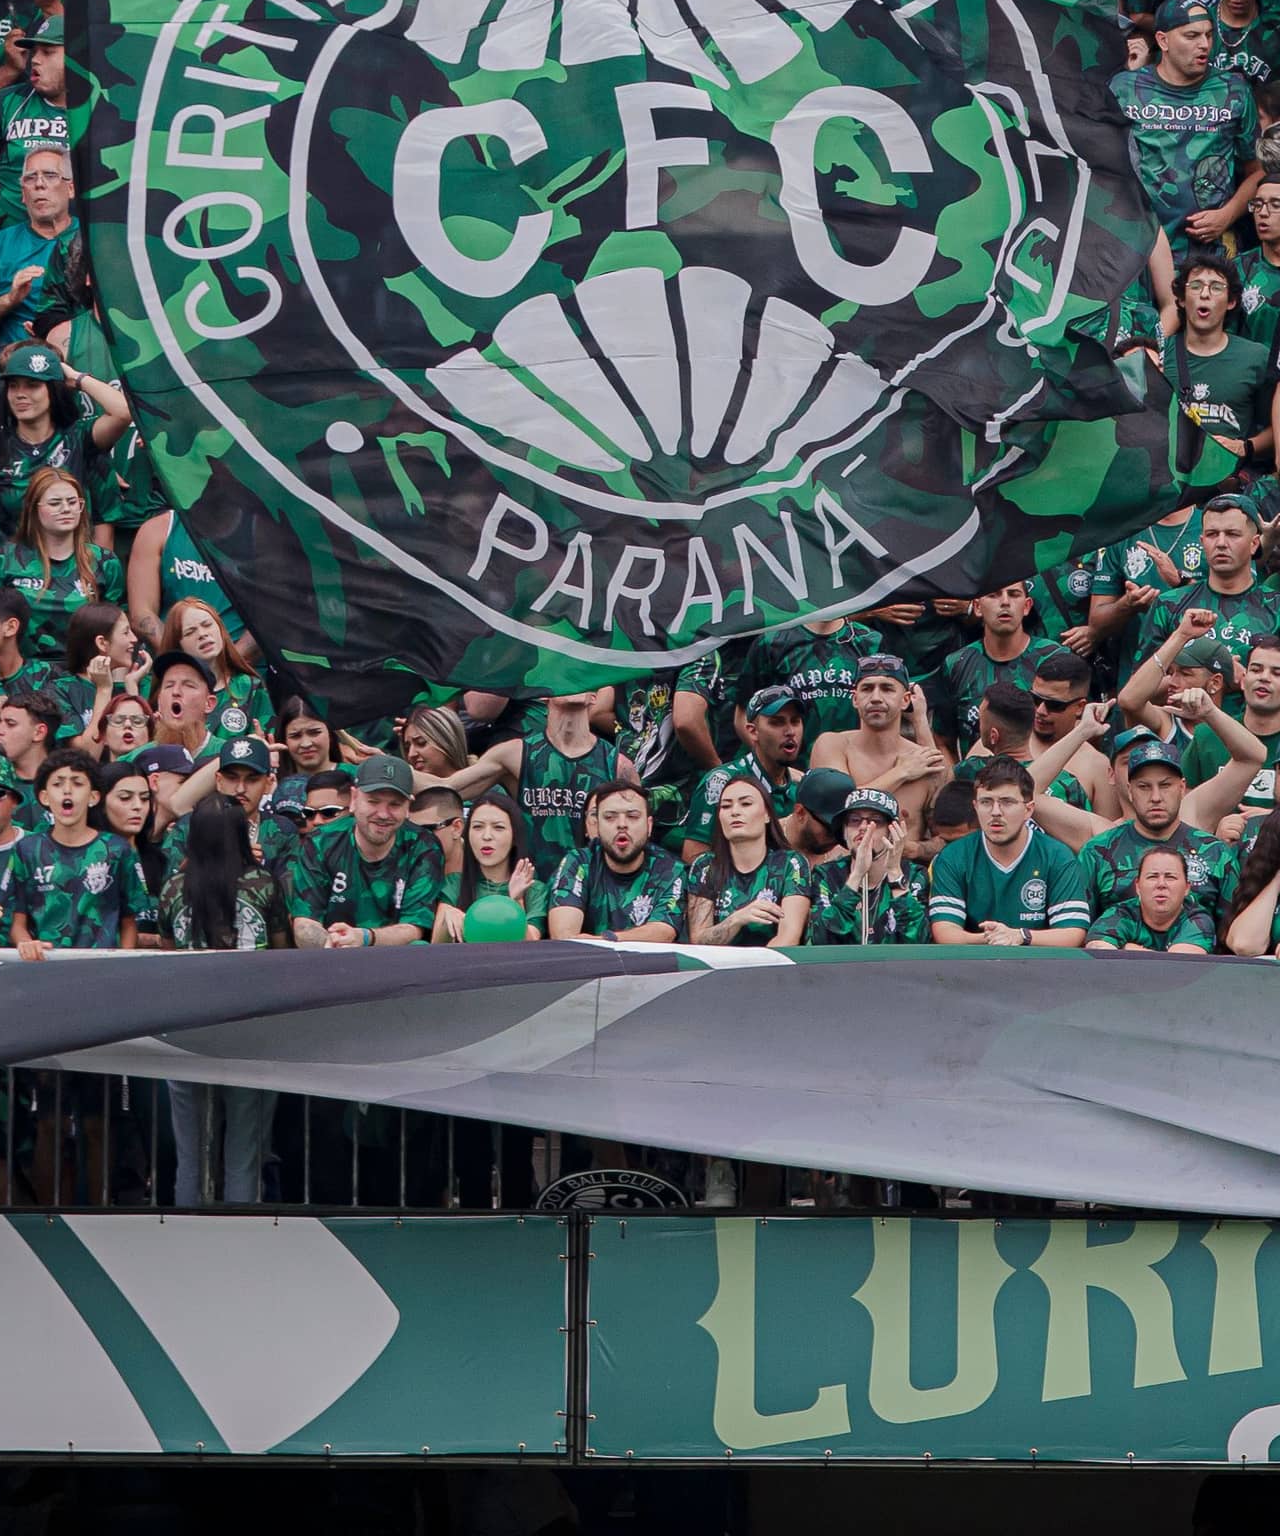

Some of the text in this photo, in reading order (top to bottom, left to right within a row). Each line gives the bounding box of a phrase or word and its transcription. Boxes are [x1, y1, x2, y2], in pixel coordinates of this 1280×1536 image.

[1125, 105, 1233, 125] RODOVIA
[393, 80, 939, 306] CFC
[467, 454, 892, 637] PARANÁ
[33, 865, 56, 885] 47
[569, 1171, 613, 1193] BALL
[616, 1172, 665, 1201] CLUB
